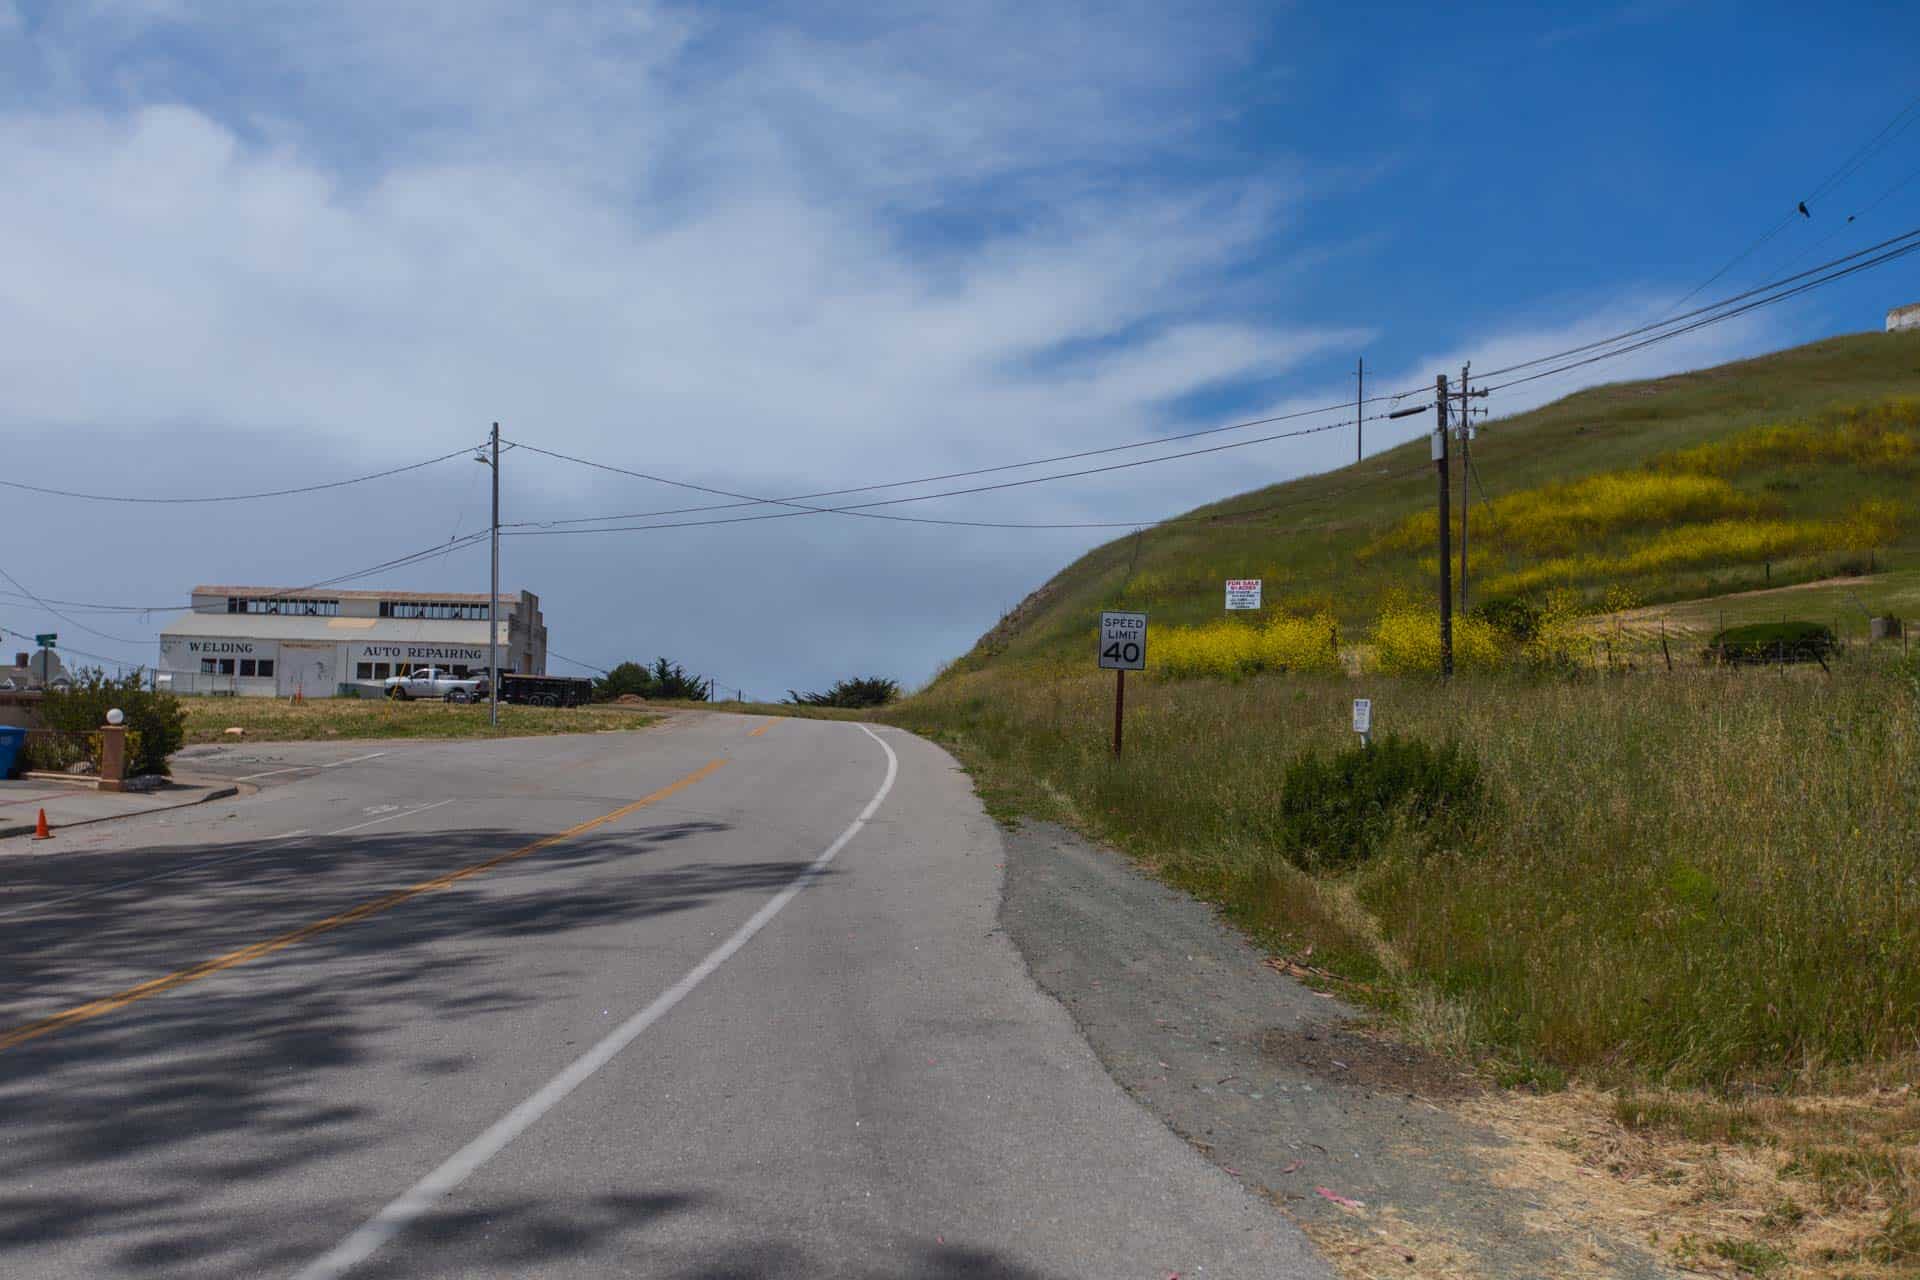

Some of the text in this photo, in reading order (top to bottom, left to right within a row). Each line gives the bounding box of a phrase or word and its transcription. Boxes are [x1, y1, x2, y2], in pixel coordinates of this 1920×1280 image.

[1104, 617, 1144, 629] SPEED
[1108, 630, 1139, 640] LIMIT
[190, 642, 253, 653] WELDING
[363, 647, 481, 659] AUTO REPAIRING
[1103, 642, 1140, 663] 40
